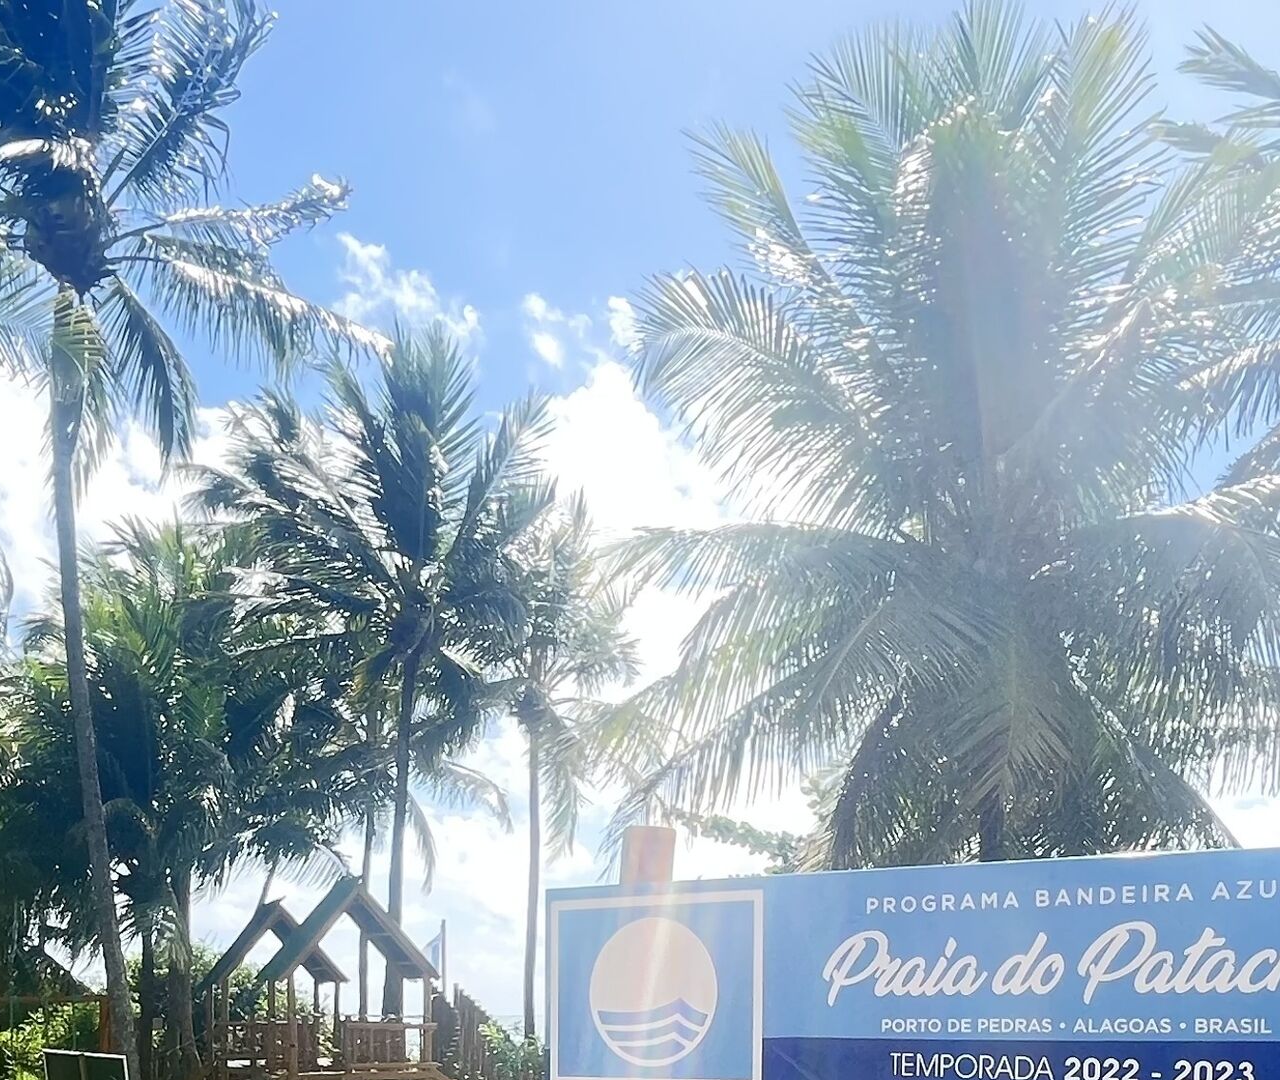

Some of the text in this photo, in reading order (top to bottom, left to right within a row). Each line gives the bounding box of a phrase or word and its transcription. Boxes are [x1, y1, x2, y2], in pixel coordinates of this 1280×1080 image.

[866, 890, 1018, 914] PROGRAMA
[1035, 883, 1193, 907] BANDEIRA
[823, 930, 987, 1006] Praia
[991, 932, 1065, 995] do
[881, 1018, 1272, 1033] PORTO DE PEDRAS ALAGOAS BRASIL
[890, 1052, 1054, 1080] TEMPORADA
